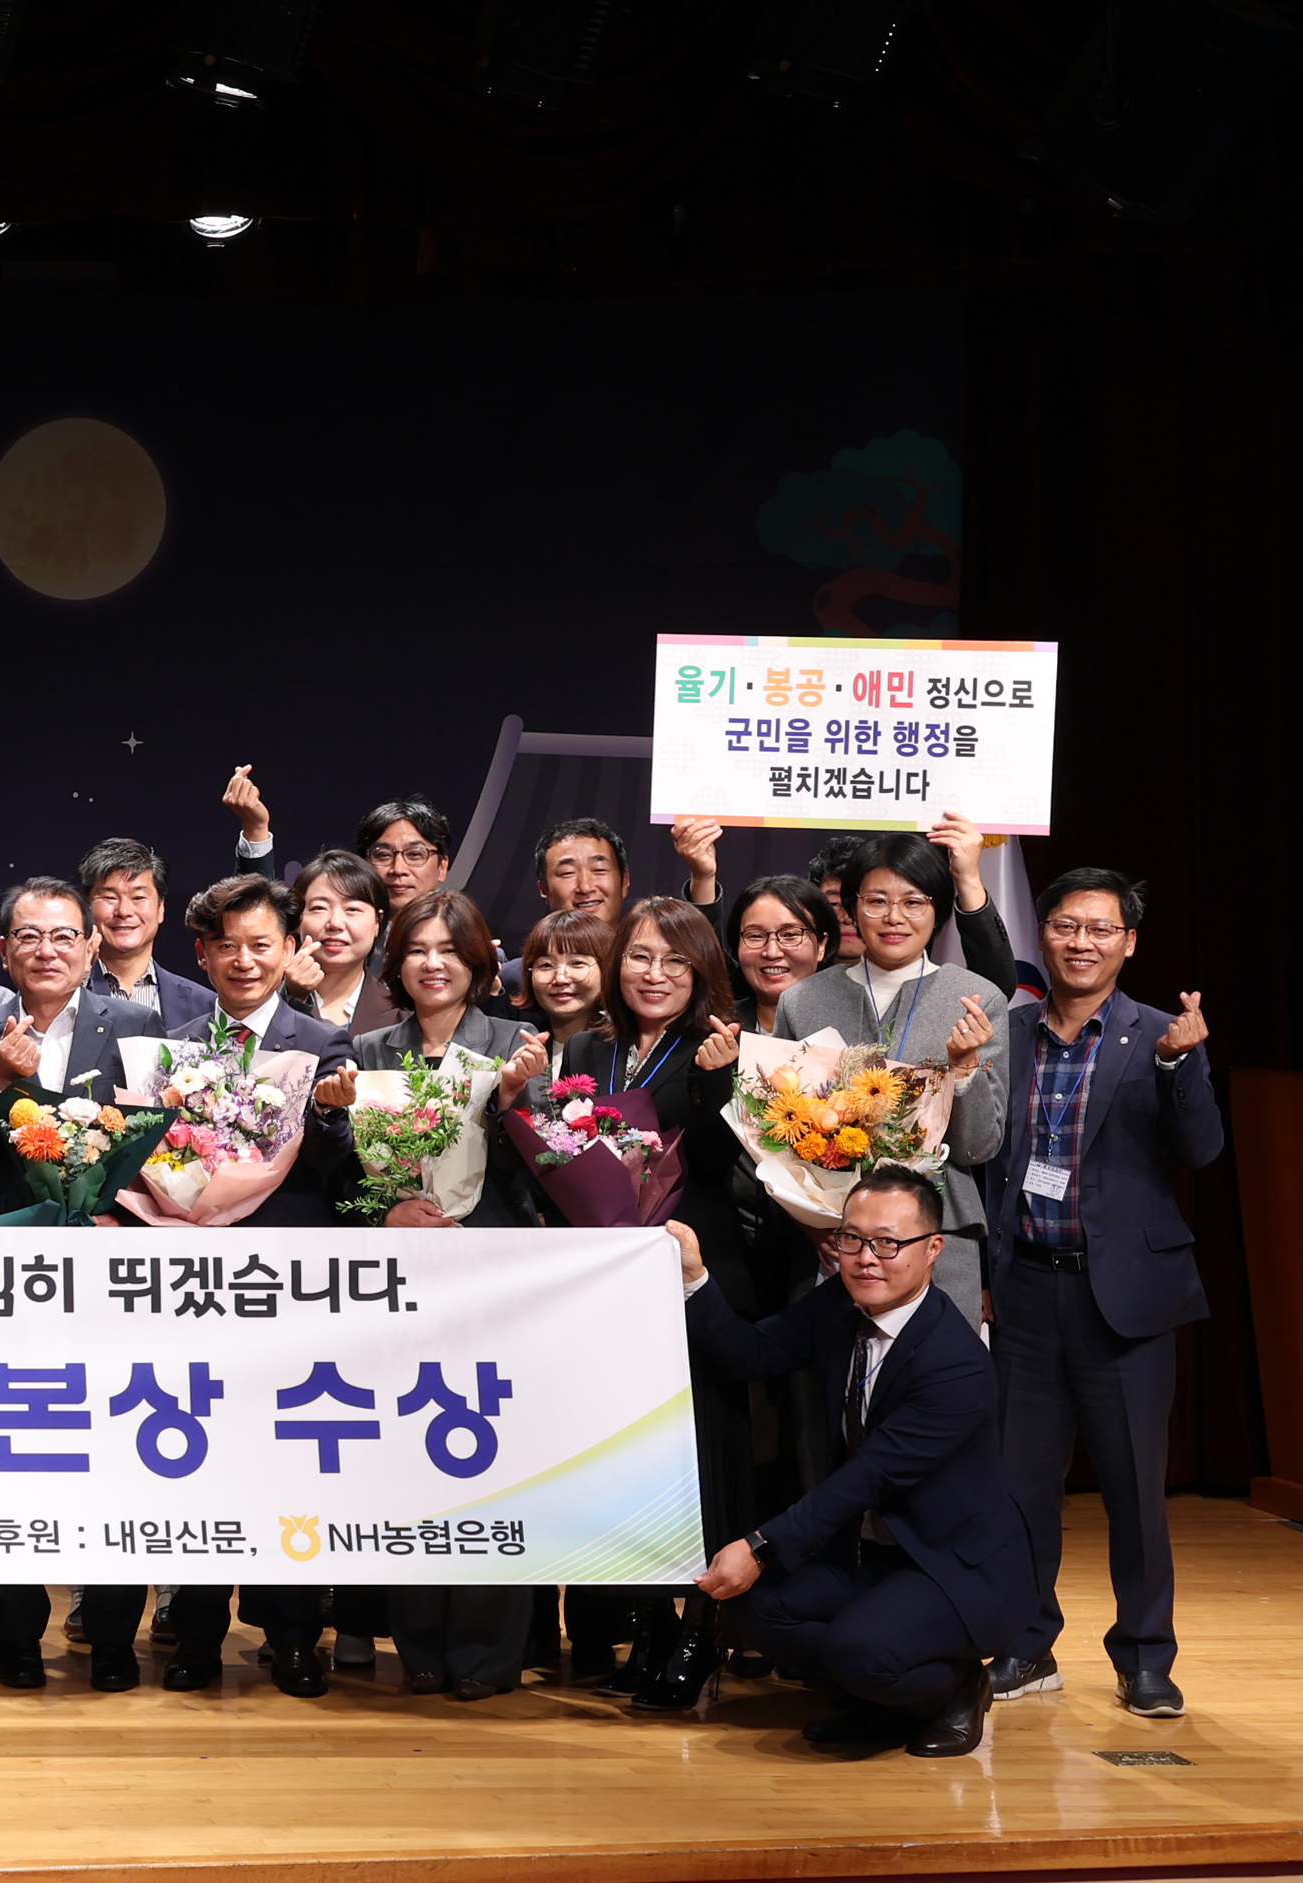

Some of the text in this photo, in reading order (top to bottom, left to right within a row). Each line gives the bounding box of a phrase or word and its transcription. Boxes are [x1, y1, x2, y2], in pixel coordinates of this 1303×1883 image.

[927, 677, 1034, 709] 정신으로
[725, 718, 978, 757] 군민을 위한 행정을
[769, 766, 930, 801] 펼치겠습니다
[109, 1254, 417, 1318] 뛰겠습니다.
[275, 1362, 513, 1478] 수상
[105, 1521, 257, 1556] 내일신문,
[329, 1520, 525, 1555] NH농협은행
